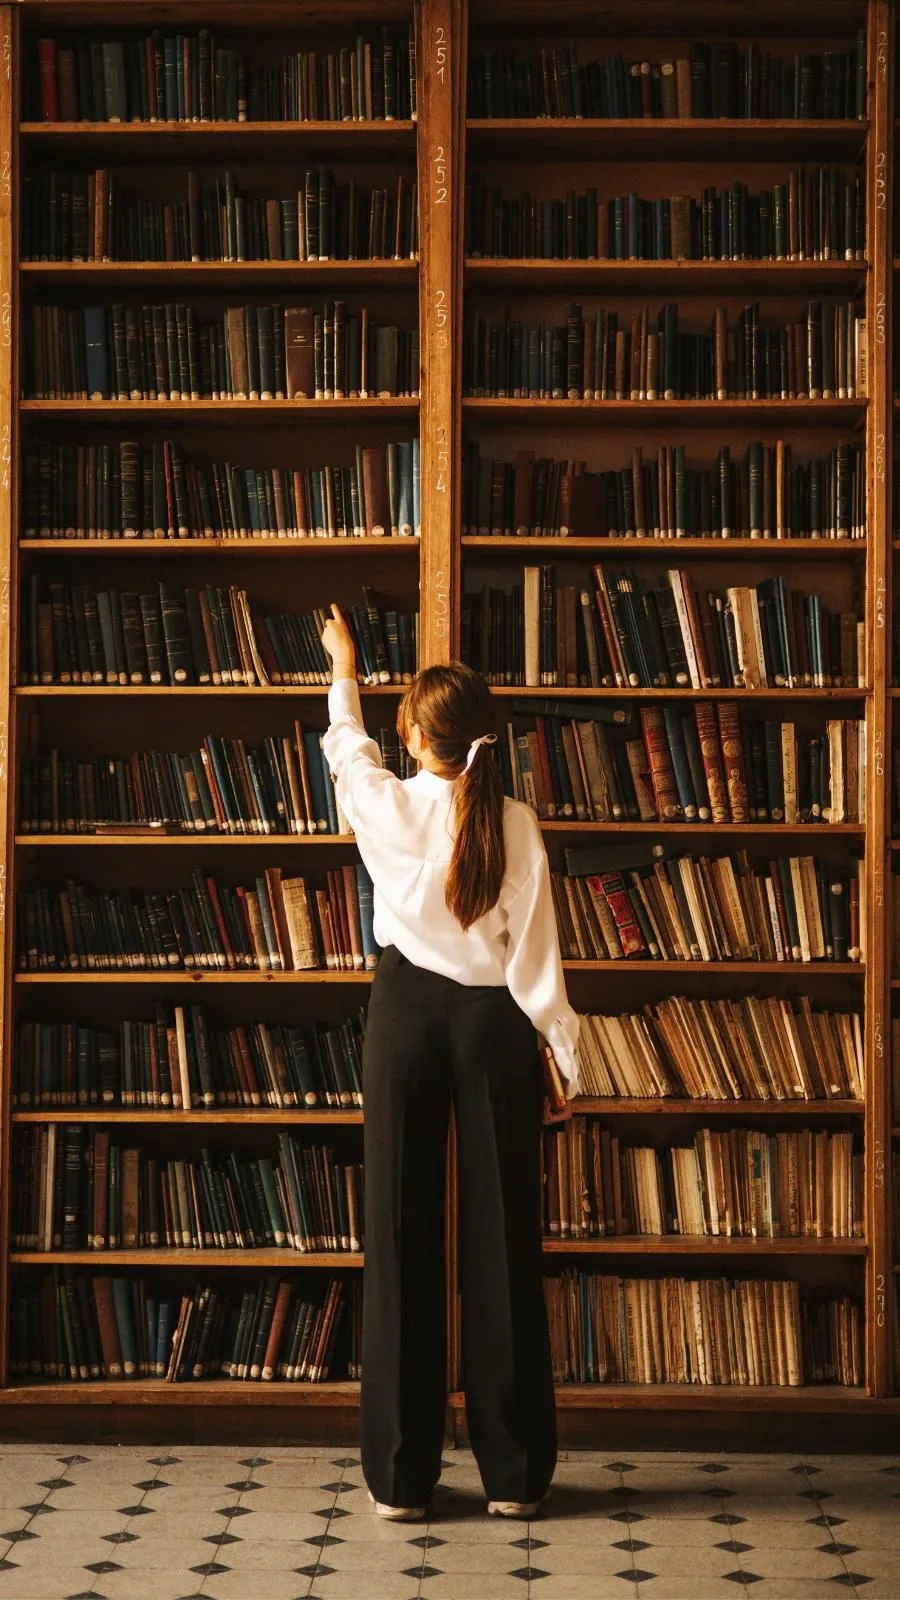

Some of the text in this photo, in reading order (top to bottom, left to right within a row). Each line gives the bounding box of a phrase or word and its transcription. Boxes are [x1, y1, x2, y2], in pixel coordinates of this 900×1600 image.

[435, 27, 447, 84] 251
[434, 146, 447, 204] 252
[434, 290, 448, 349] 253
[436, 426, 448, 493] 254
[876, 1274, 885, 1327] 270
